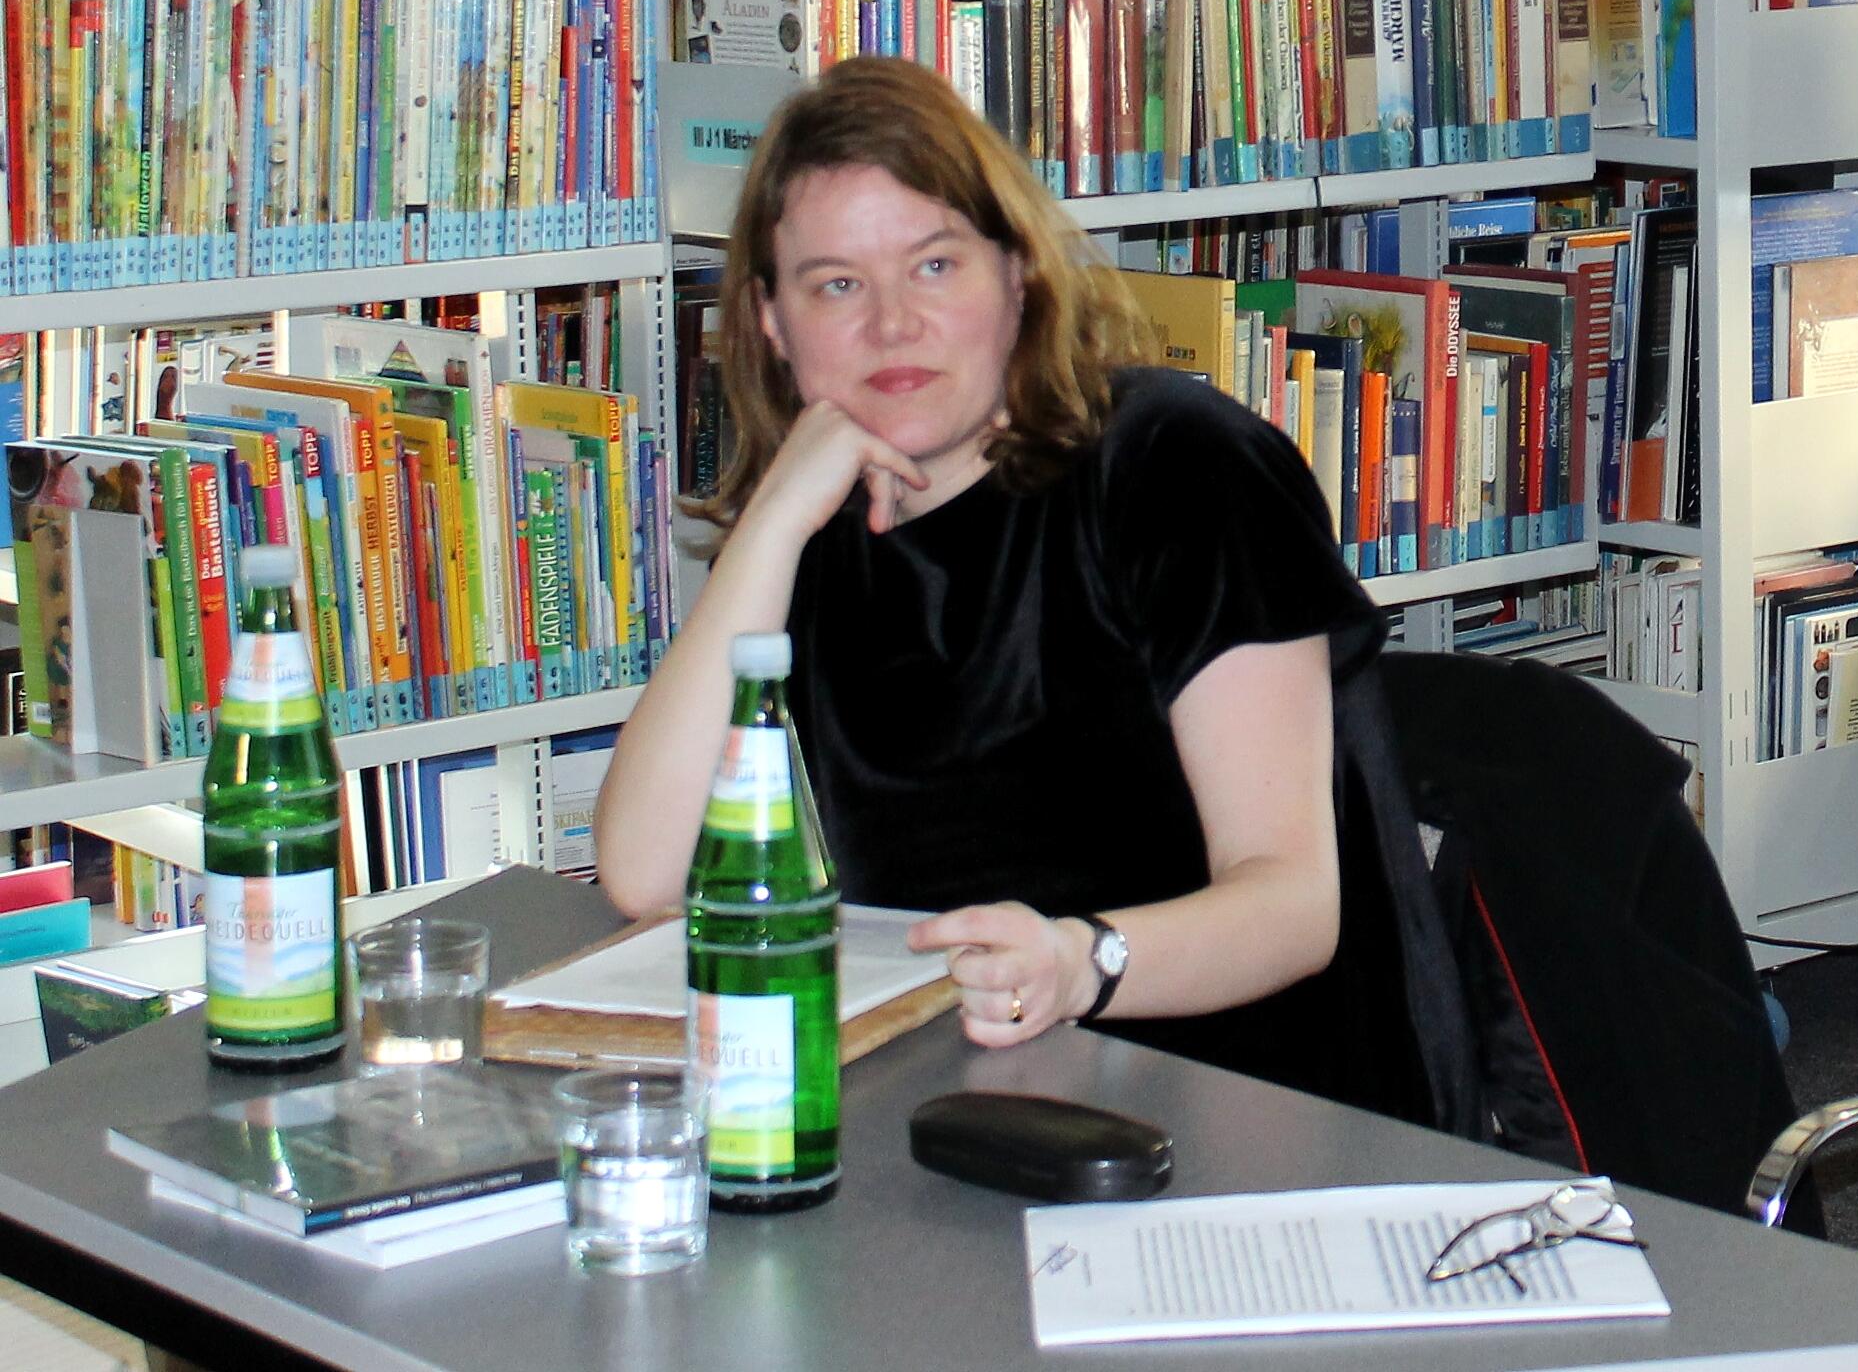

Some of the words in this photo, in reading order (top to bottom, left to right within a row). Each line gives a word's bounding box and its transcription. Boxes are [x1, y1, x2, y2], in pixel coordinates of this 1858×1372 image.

[1278, 23, 1287, 39] der
[1278, 41, 1288, 90] Chinesen
[724, 127, 758, 149] Märche
[510, 153, 520, 176] Das
[138, 150, 152, 233] Halloween
[1479, 223, 1503, 237] Reise
[1447, 295, 1461, 354] ODYSSEE
[1446, 356, 1458, 377] Die
[609, 401, 621, 439] TOPP
[1613, 405, 1624, 419] für
[266, 444, 278, 482] TOPP
[305, 432, 320, 474] TOPP
[360, 429, 373, 467] TOPP
[175, 461, 186, 499] Kinder
[177, 502, 188, 518] für
[196, 482, 208, 525] goldene
[364, 496, 379, 549] HERBST
[385, 476, 398, 549] BASTELBUCH
[207, 477, 223, 578] Bastelbuch
[181, 521, 192, 583] Bastelbuch
[200, 558, 211, 579] Das
[374, 555, 387, 631] BASTELBUCH
[537, 533, 561, 646] FADENSPIELE
[186, 614, 197, 637] Das
[699, 1045, 783, 1069] EQUELL
